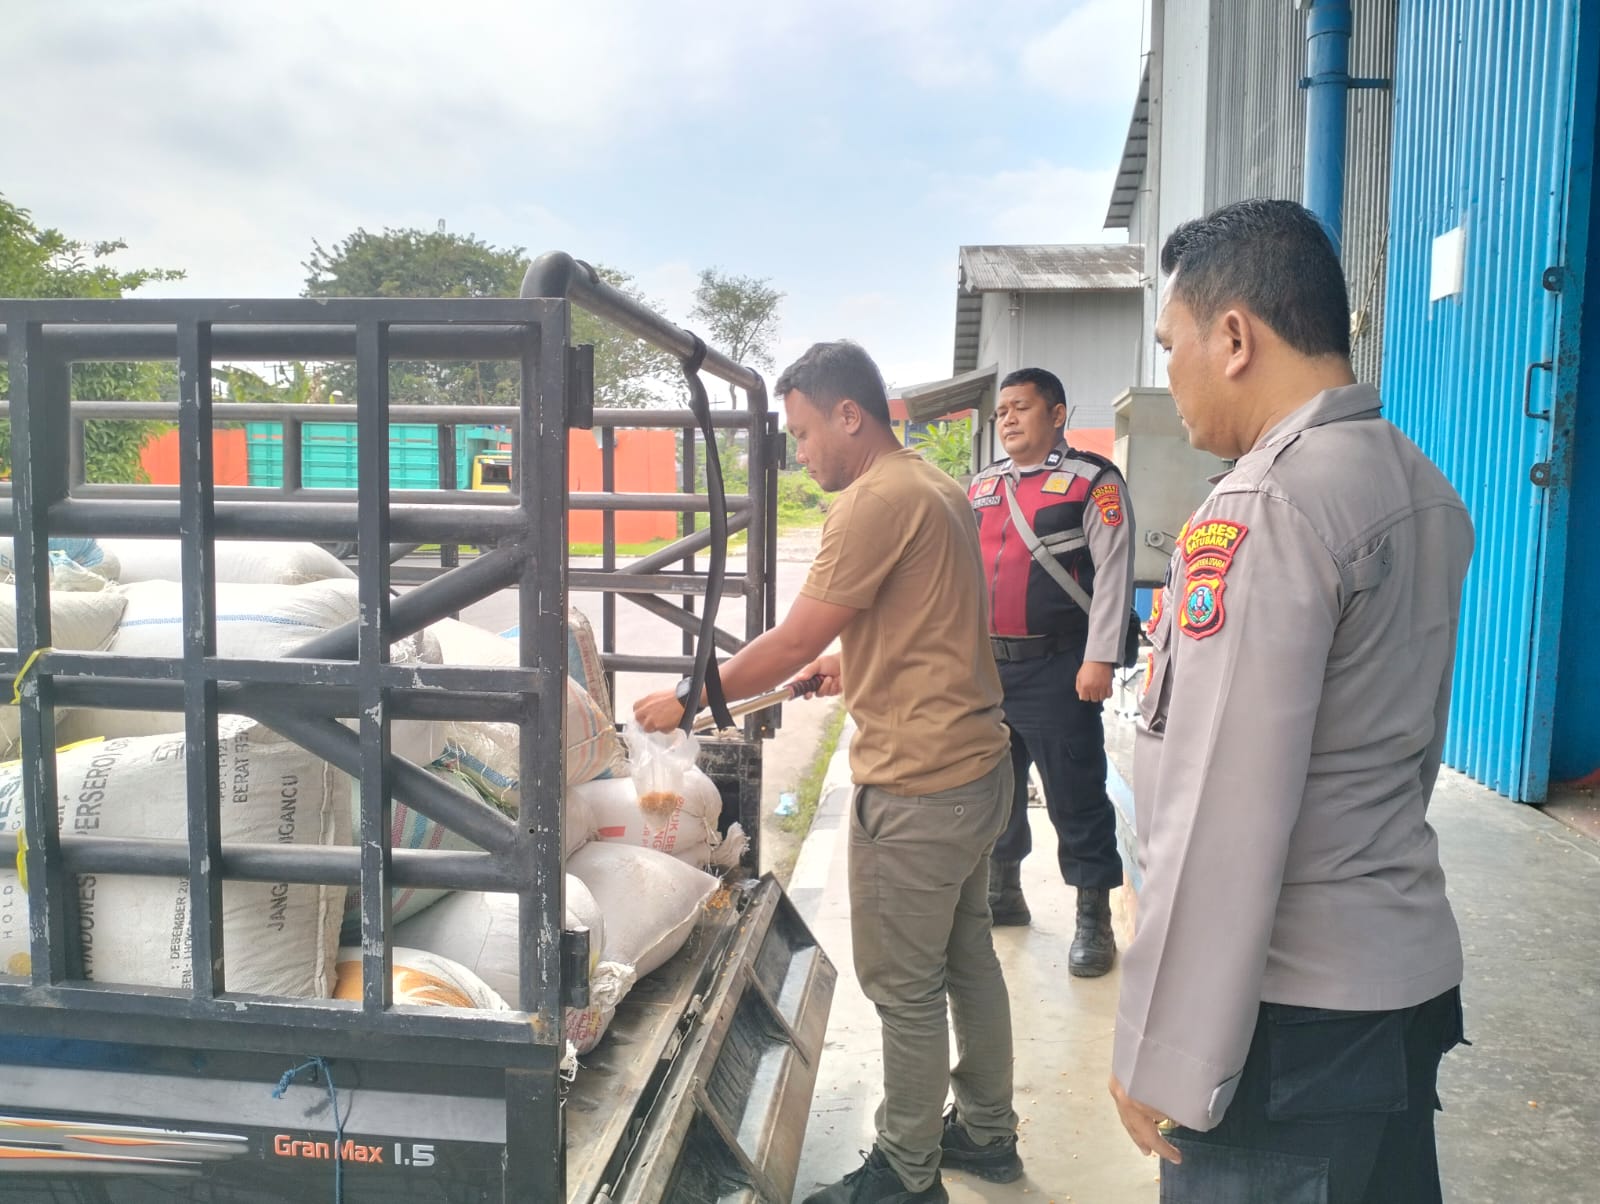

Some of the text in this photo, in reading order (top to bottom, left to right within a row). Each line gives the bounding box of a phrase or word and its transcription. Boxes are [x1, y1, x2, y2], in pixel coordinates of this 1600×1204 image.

[1187, 523, 1239, 546] POLRES
[232, 758, 250, 804] BERAT
[266, 774, 299, 932] JANG IGANCU
[170, 896, 186, 960] DESEMBER
[274, 1134, 330, 1160] Gran
[334, 1139, 384, 1163] Max
